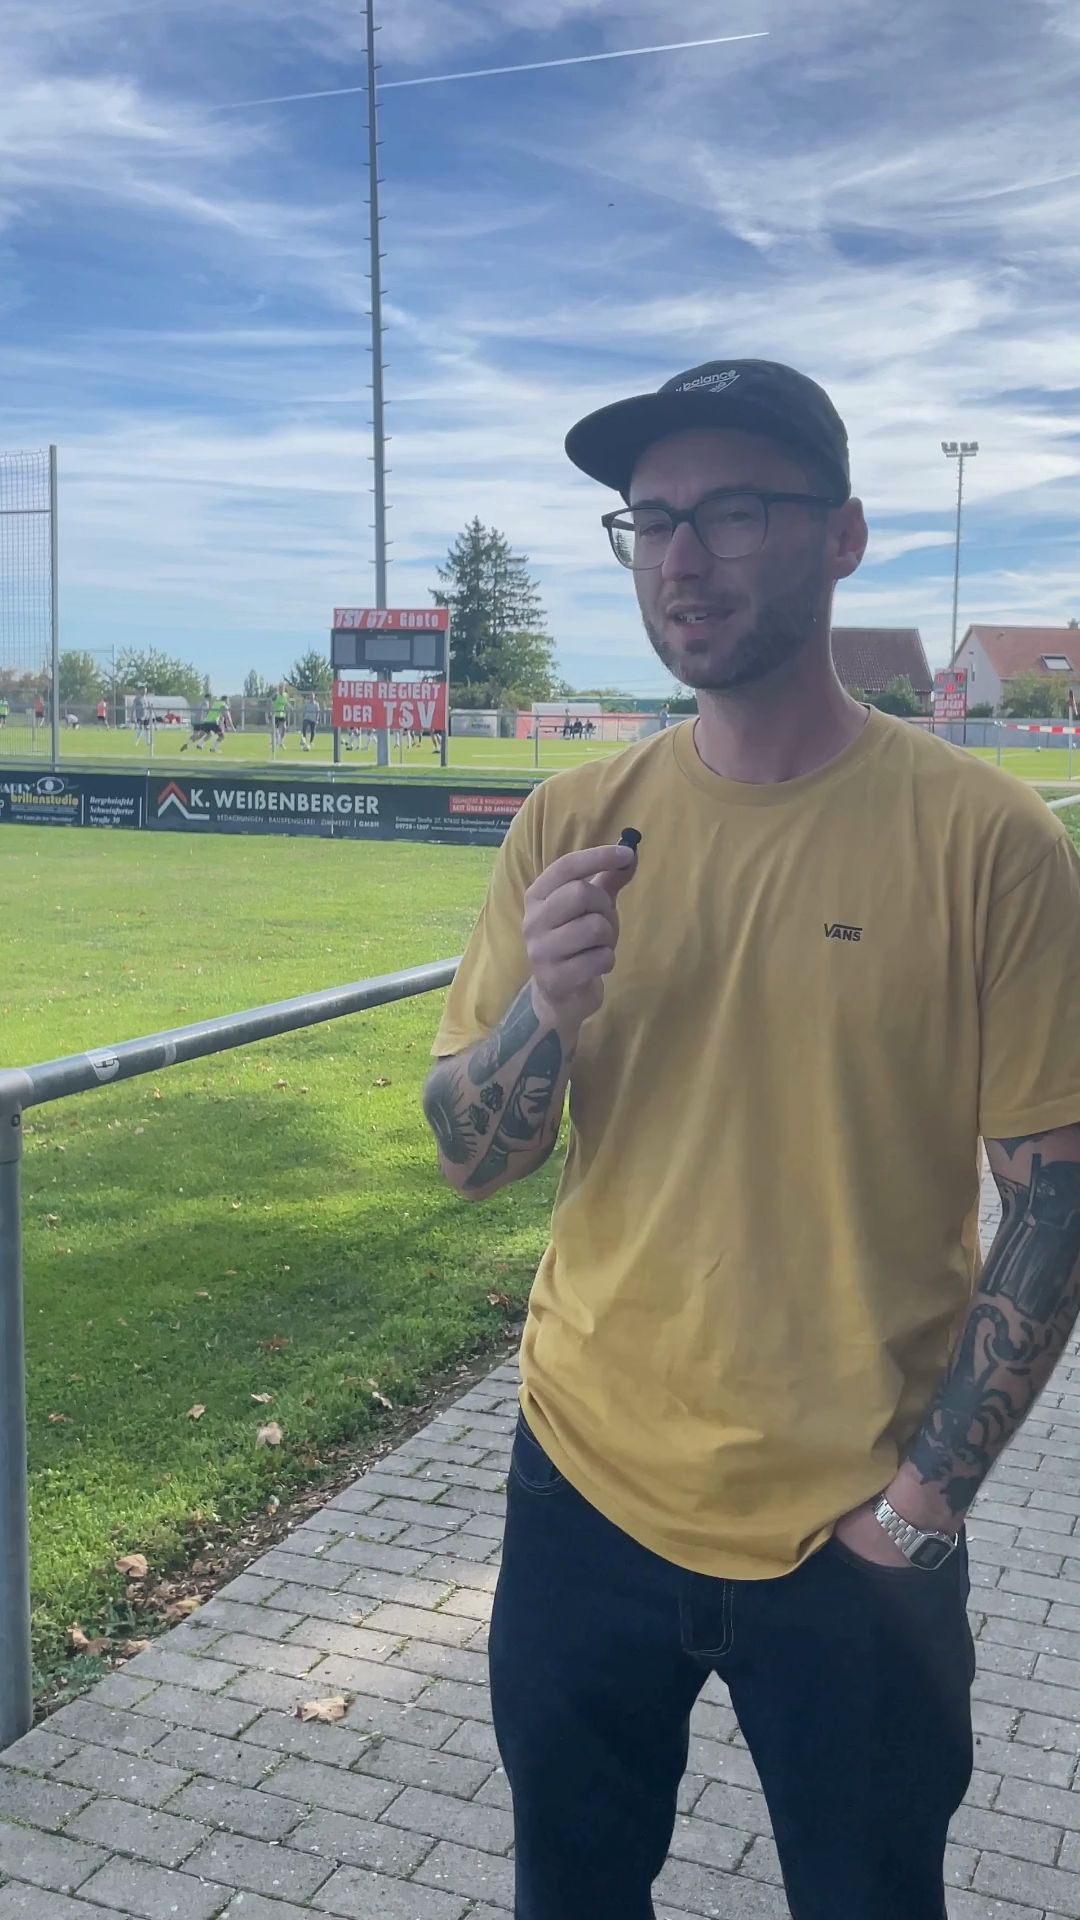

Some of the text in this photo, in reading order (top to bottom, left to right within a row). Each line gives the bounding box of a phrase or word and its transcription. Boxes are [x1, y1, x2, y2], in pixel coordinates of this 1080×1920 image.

[683, 370, 737, 391] balance
[336, 610, 365, 628] TSV
[338, 682, 441, 699] HIER REGIERT
[342, 701, 436, 729] DER TSV
[190, 788, 380, 815] K. WEIßENBERGER
[824, 923, 863, 942] VANS
